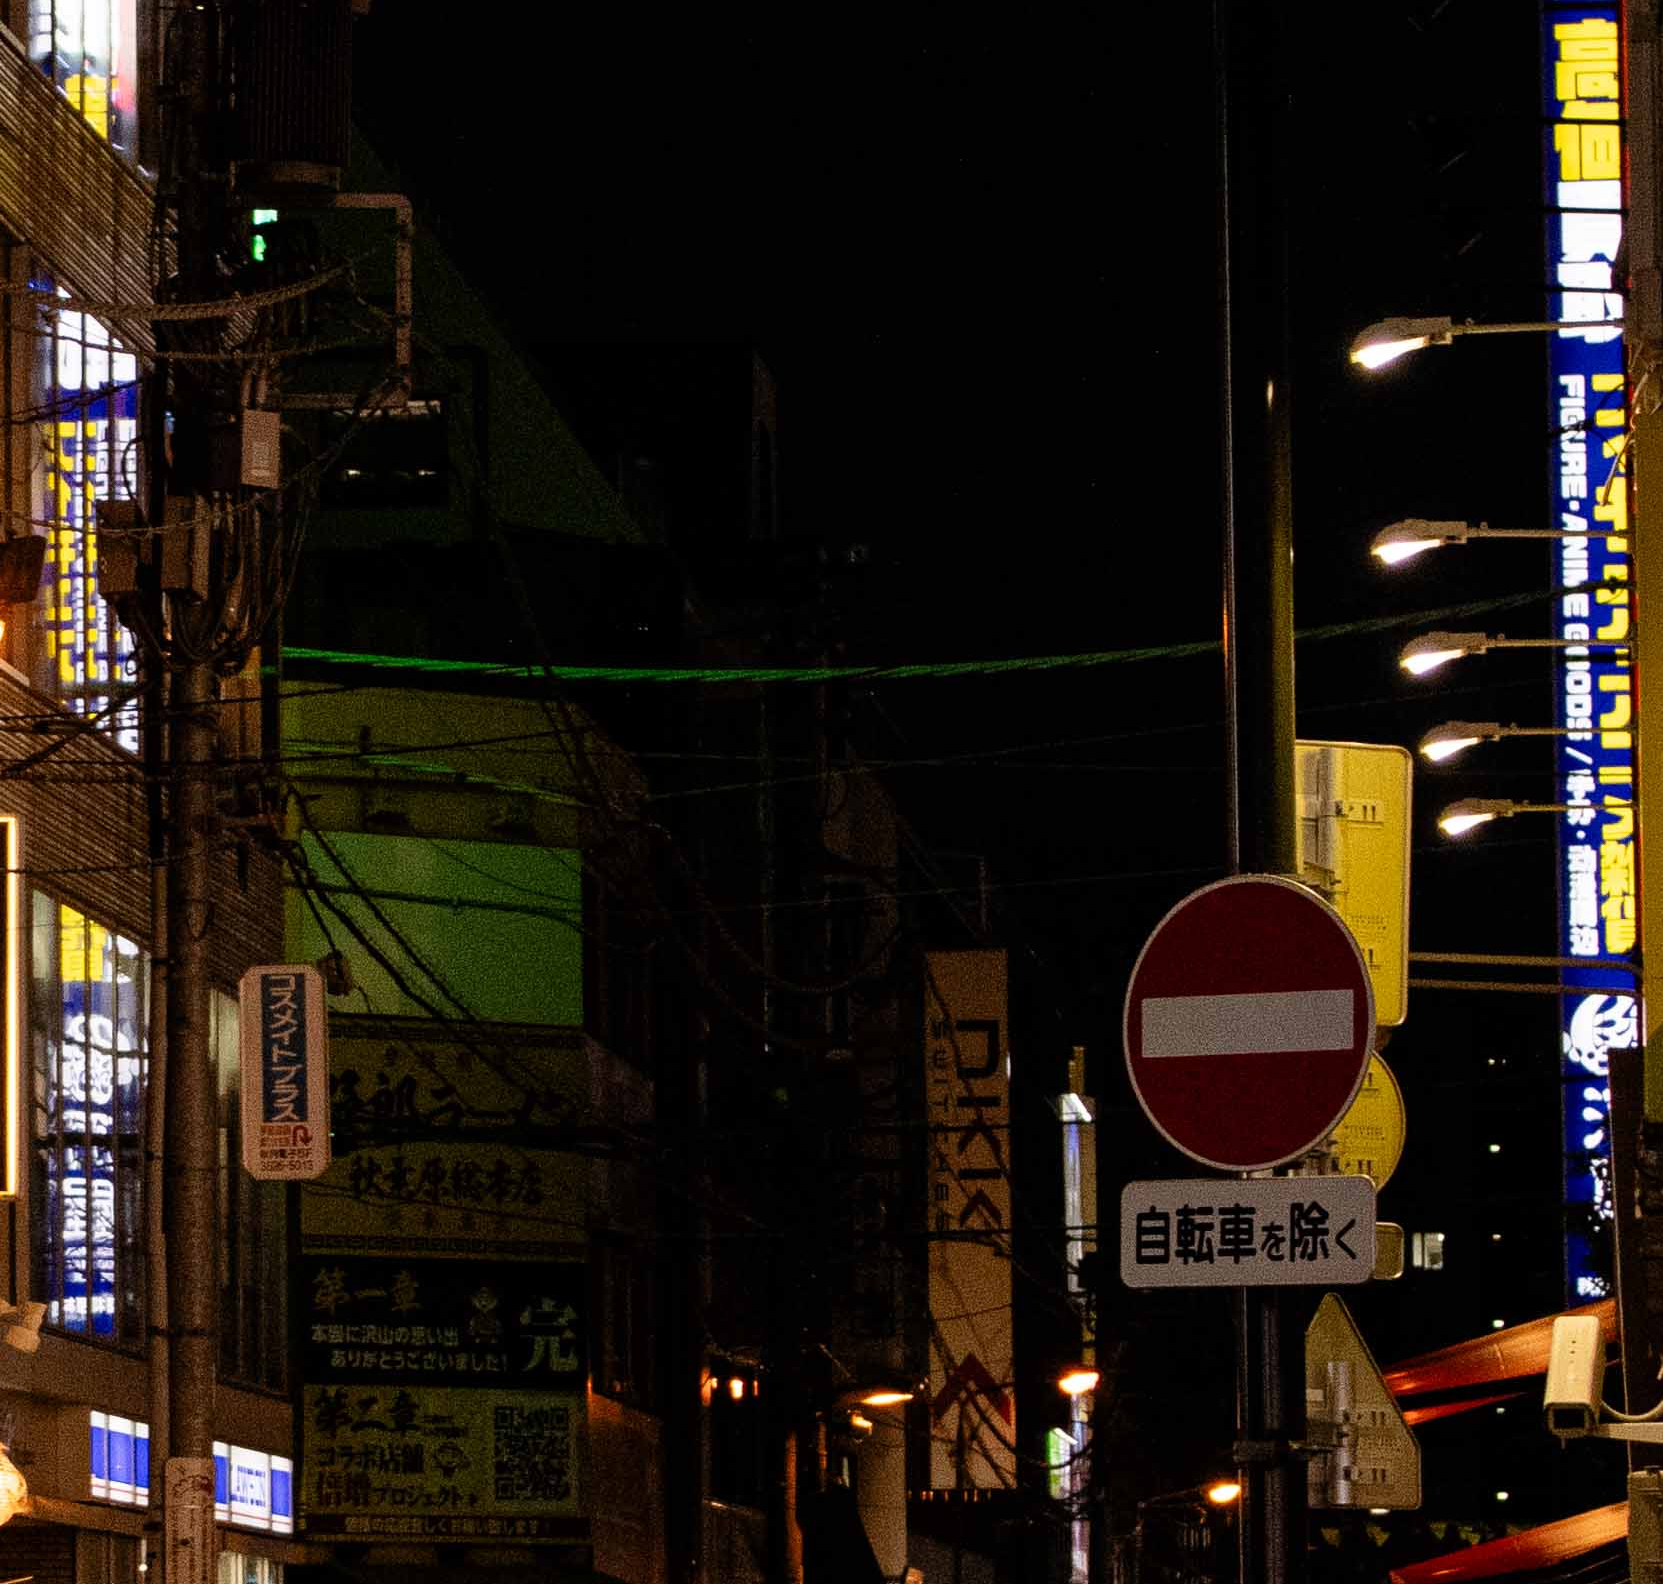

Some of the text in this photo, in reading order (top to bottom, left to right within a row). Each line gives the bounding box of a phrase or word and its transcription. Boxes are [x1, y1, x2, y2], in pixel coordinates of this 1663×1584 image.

[269, 974, 303, 1121] コスメイトプラス
[1136, 1200, 1356, 1264] 自転車を除く
